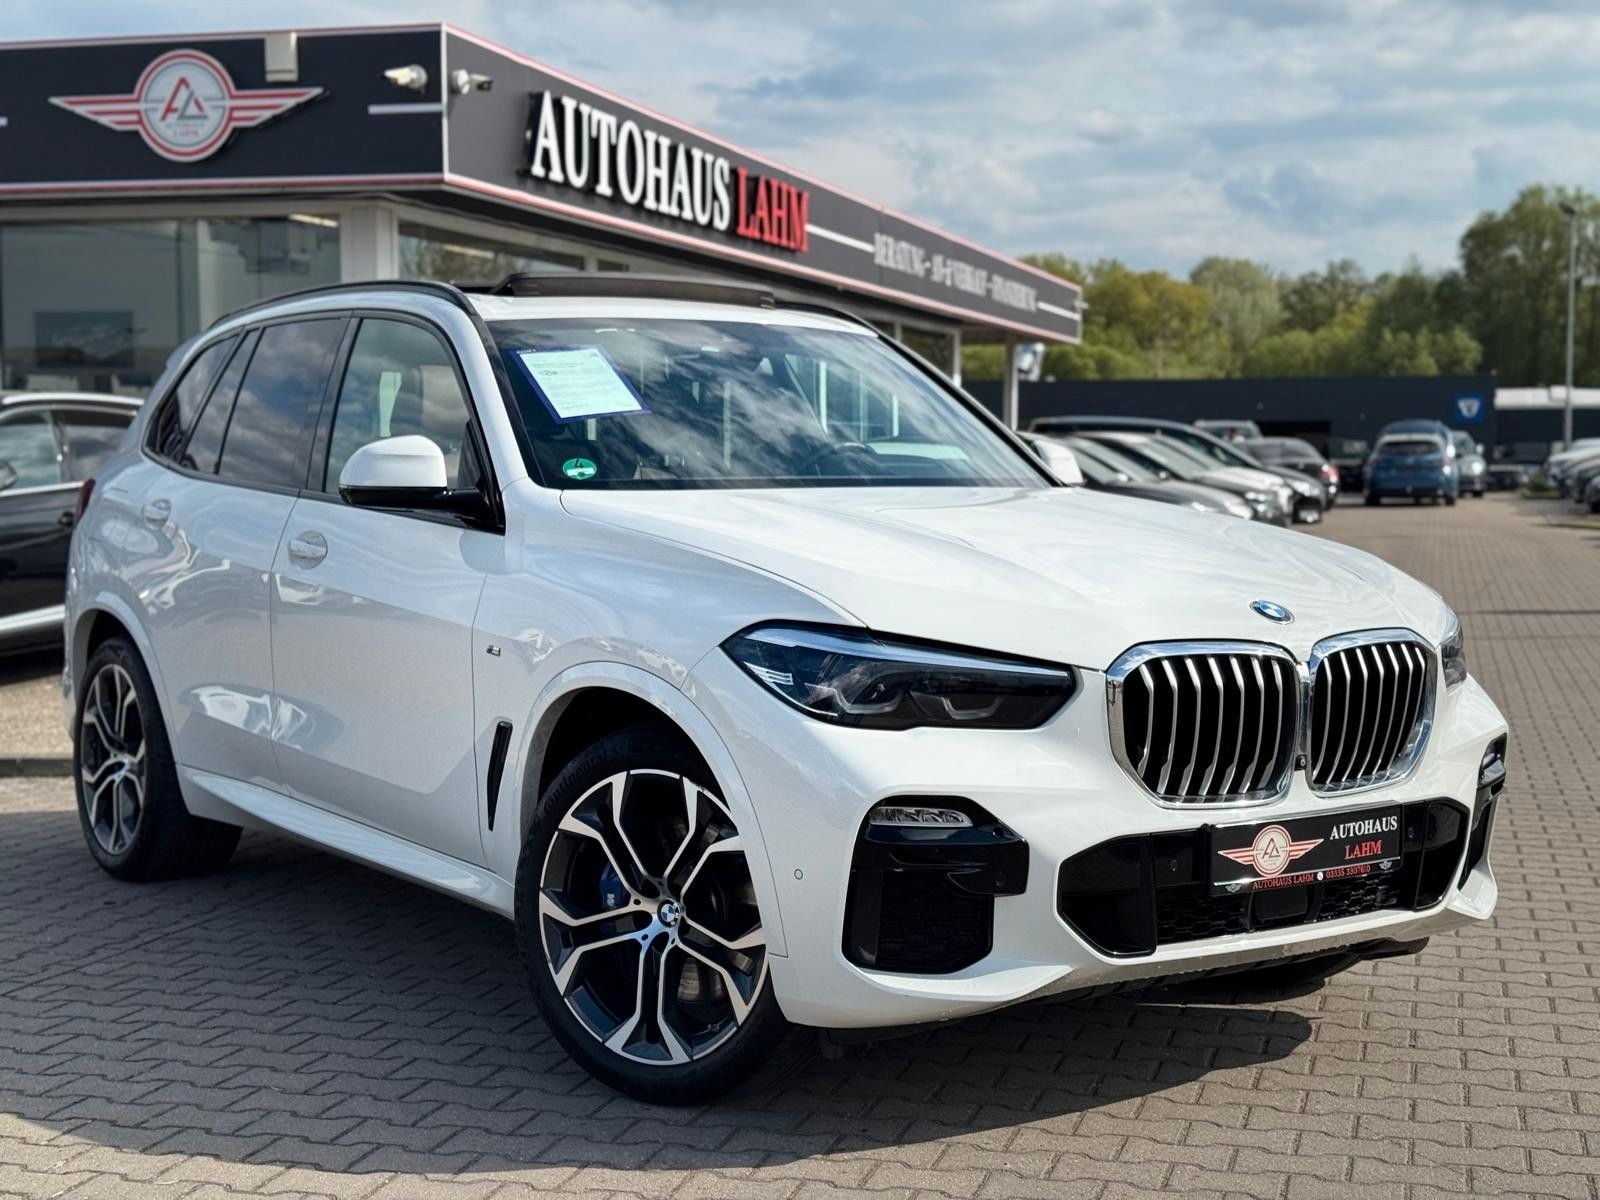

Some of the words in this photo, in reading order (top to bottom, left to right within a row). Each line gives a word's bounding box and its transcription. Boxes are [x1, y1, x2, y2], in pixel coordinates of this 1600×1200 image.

[531, 89, 730, 231] AUTOHAUS
[736, 165, 809, 253] LAHM
[1330, 816, 1397, 840] AUTOHAUS
[1344, 840, 1382, 860] LAHM
[1252, 876, 1292, 889] AUTOHAUS
[1294, 873, 1314, 884] LAHM
